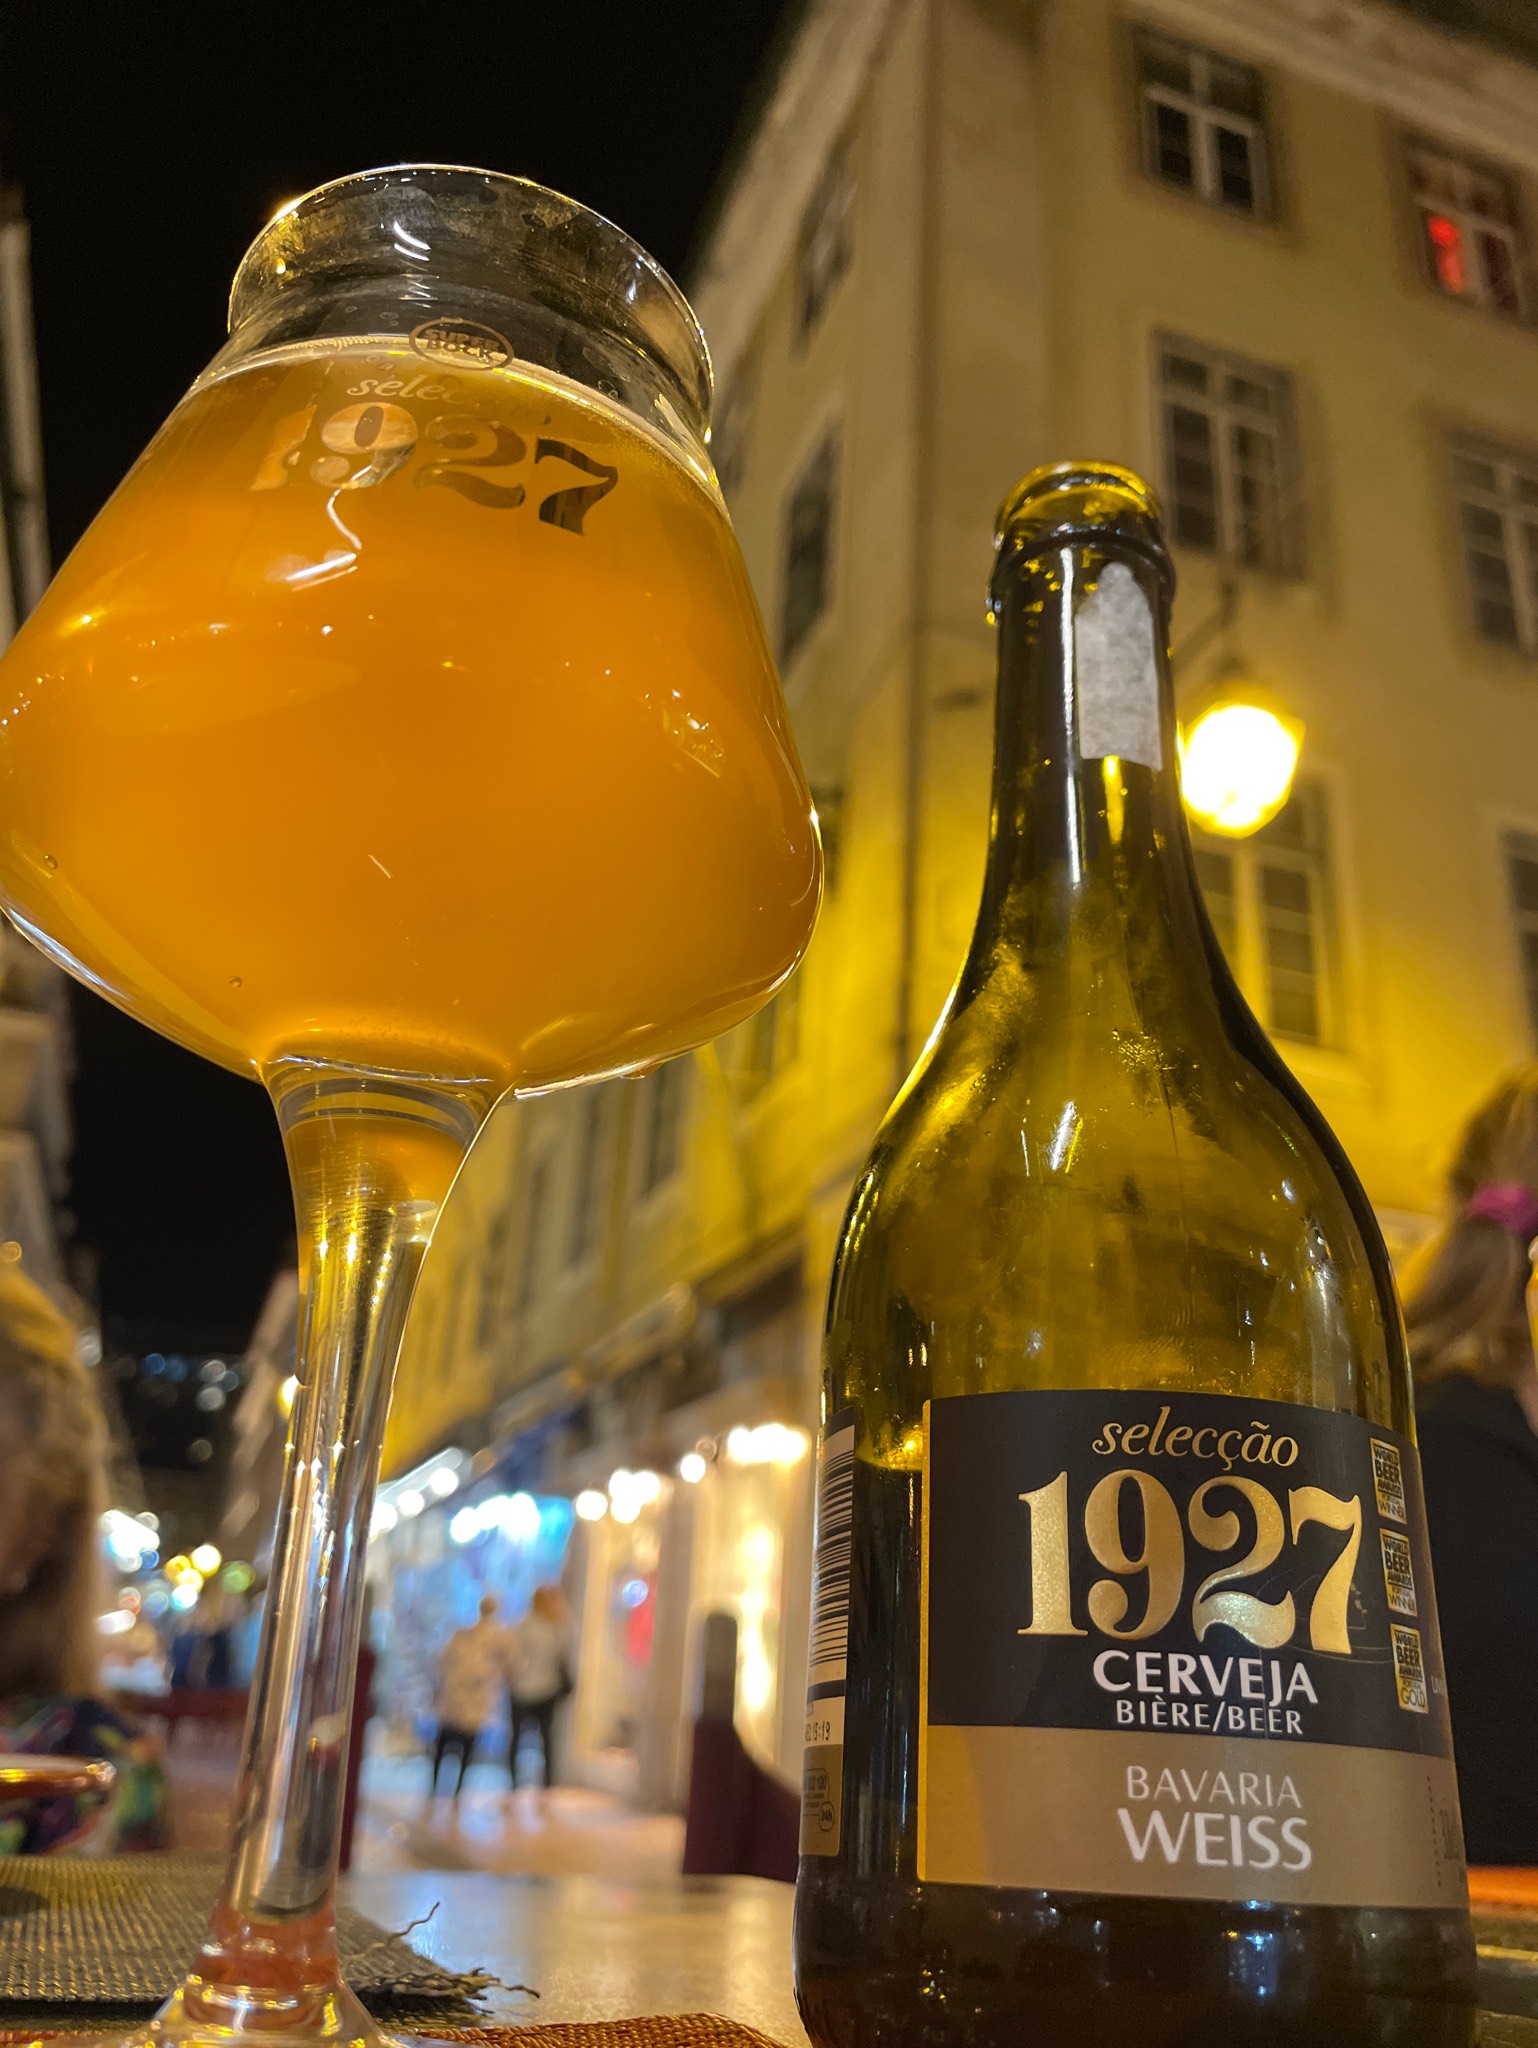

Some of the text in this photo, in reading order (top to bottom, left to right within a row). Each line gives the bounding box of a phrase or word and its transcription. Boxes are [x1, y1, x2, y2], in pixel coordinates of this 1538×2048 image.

[424, 329, 500, 352] SUPER
[426, 340, 494, 362] BOCK
[250, 396, 618, 536] 1927
[1091, 1406, 1298, 1470] selecção
[1374, 1459, 1401, 1485] BEER
[1016, 1469, 1361, 1654] 1927
[1384, 1550, 1411, 1575] BEER
[1092, 1649, 1319, 1704] CERVEJA
[1396, 1645, 1421, 1668] BEER
[1115, 1691, 1303, 1735] BIÈRE/BEER
[1401, 1687, 1426, 1708] GOLD
[1127, 1764, 1302, 1809] BAVARIA
[1116, 1807, 1312, 1872] WEISS
